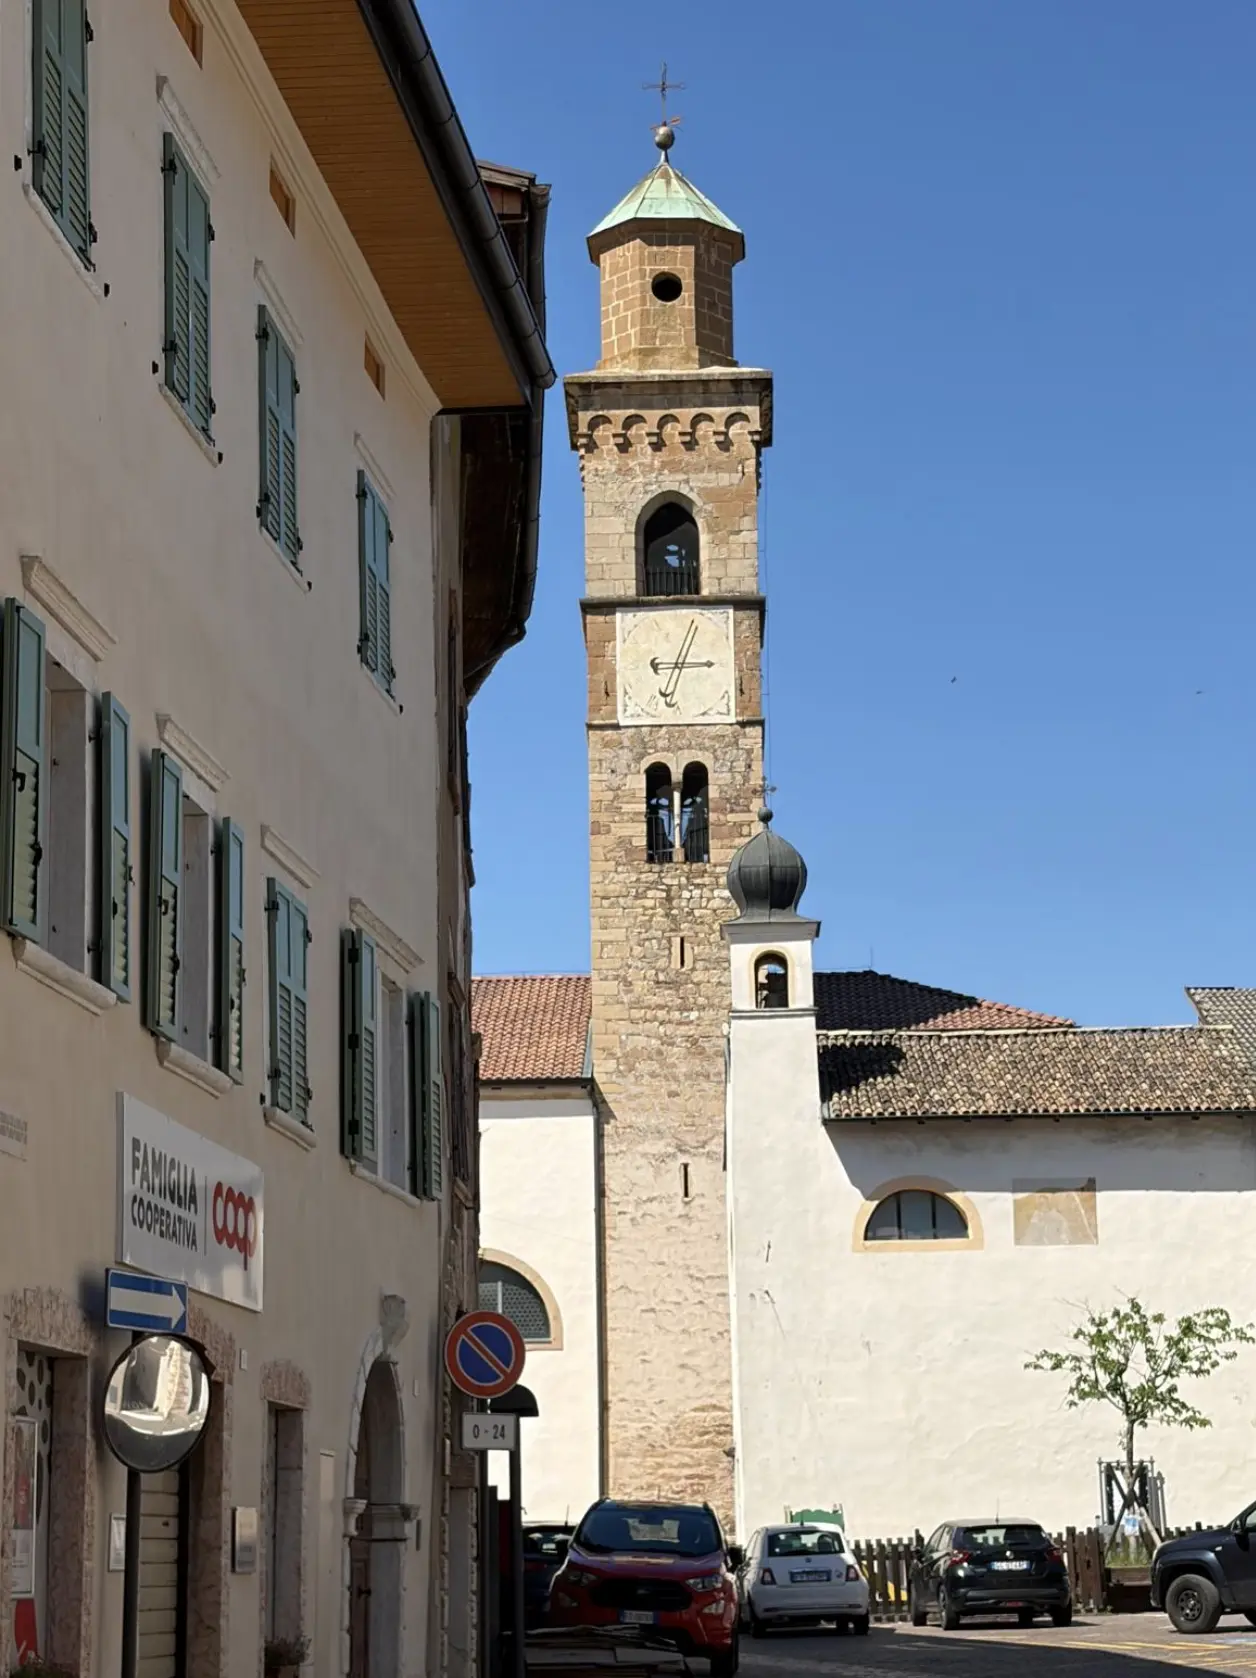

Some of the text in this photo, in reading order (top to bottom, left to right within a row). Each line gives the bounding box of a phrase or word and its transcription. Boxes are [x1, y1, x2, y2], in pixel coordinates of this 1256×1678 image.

[131, 1136, 198, 1216] FAMIGLIA
[131, 1193, 198, 1253] COOPERATIVA
[472, 1423, 480, 1440] 0
[492, 1423, 505, 1440] 24
